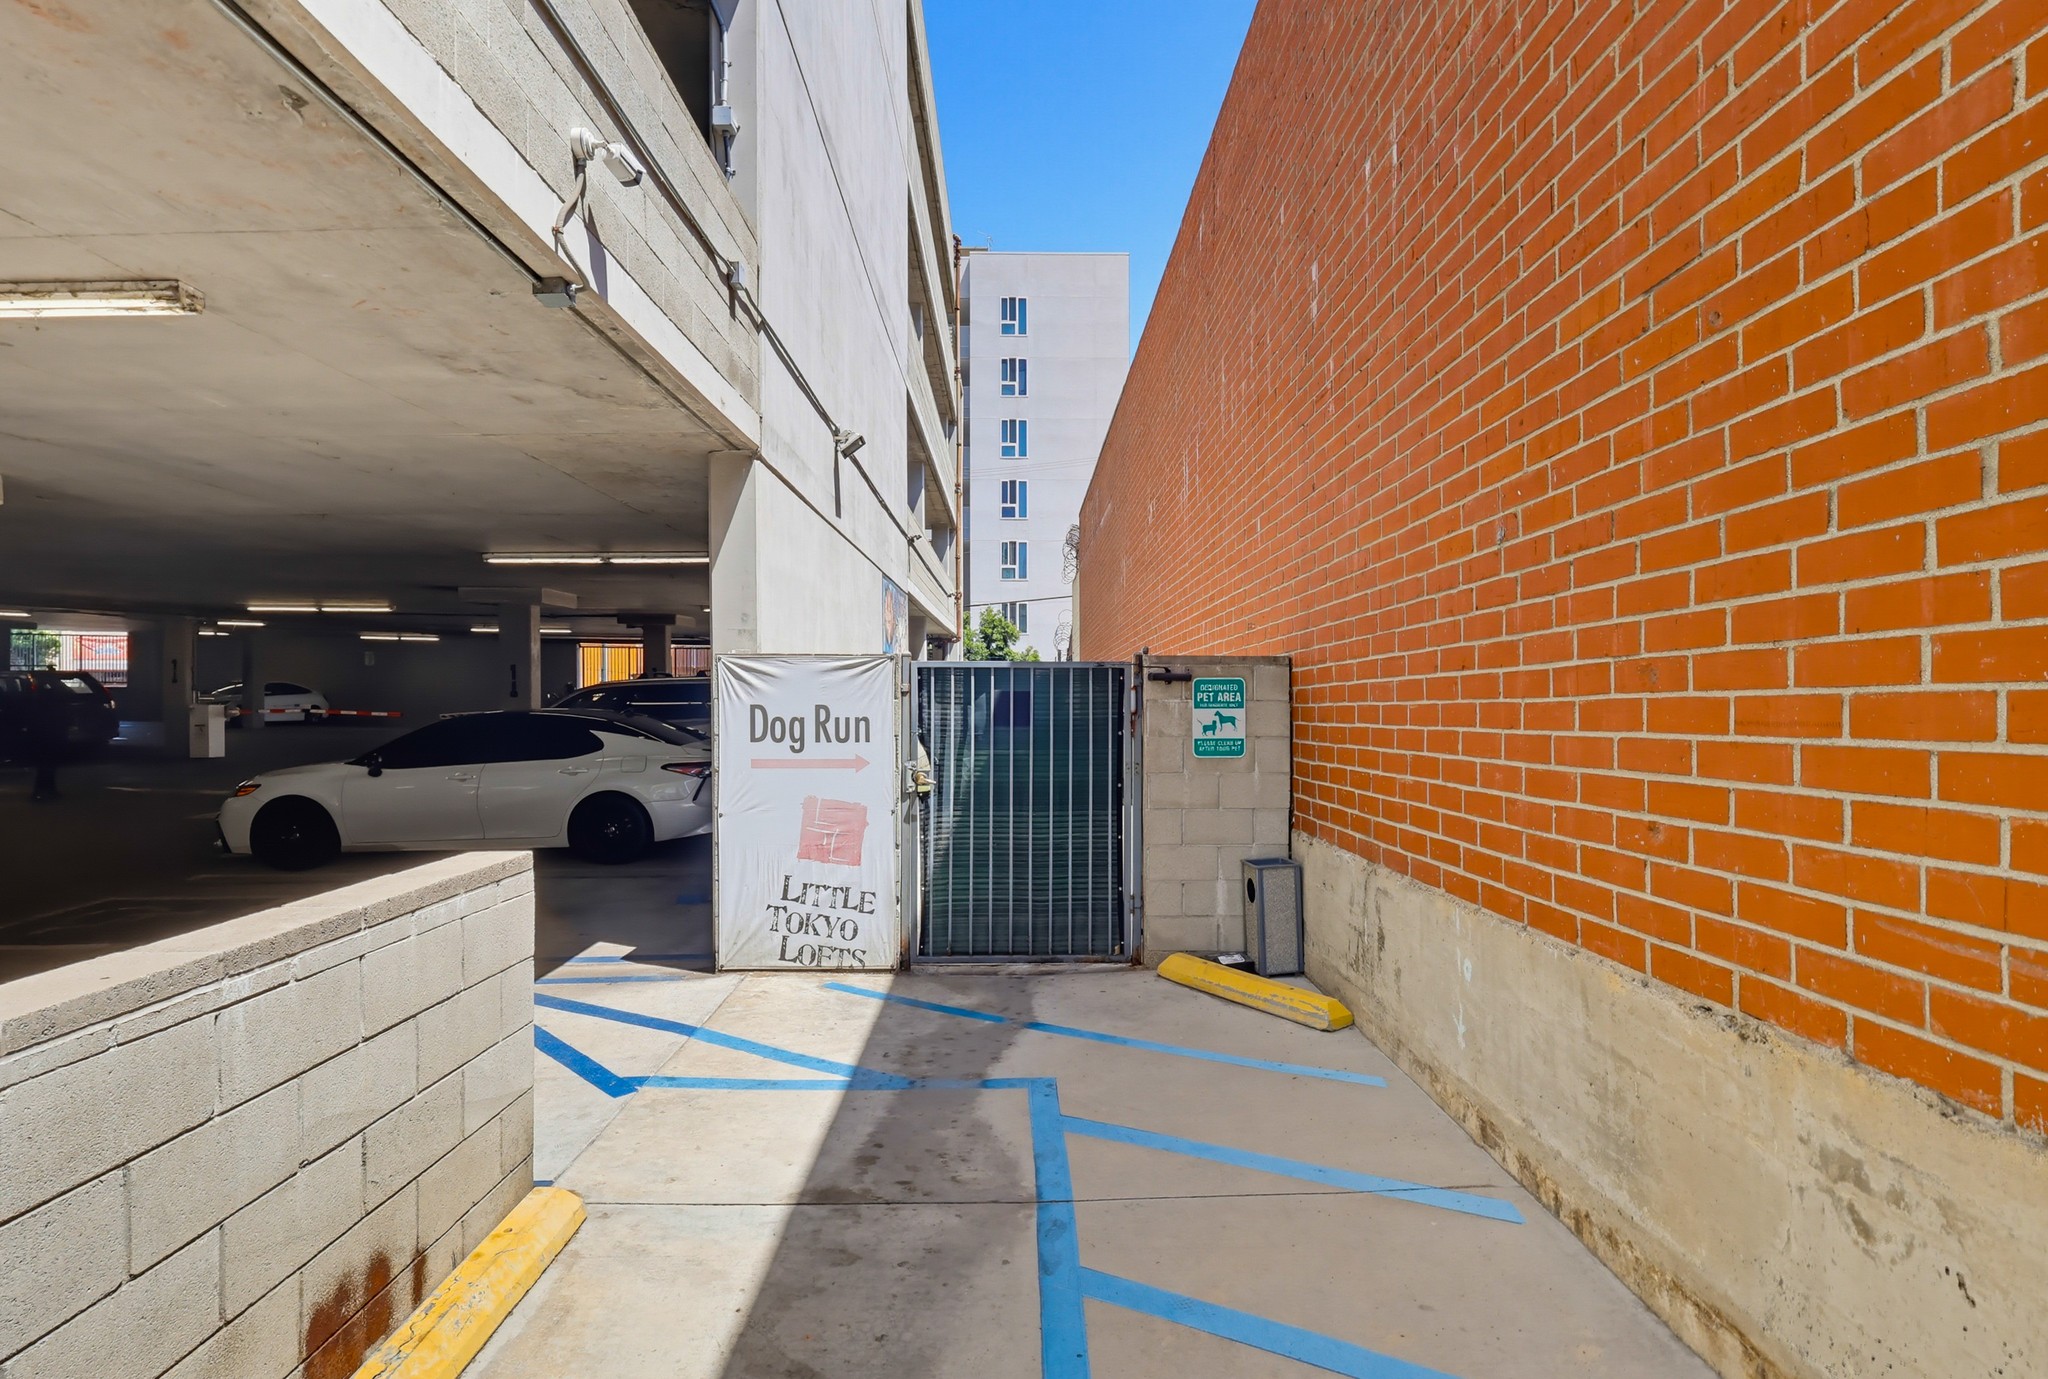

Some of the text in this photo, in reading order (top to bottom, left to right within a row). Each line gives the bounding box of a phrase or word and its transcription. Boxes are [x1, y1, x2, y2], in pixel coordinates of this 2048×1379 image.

[1197, 692, 1242, 702] PET AREA
[749, 704, 870, 754] Dog Run
[780, 874, 877, 915] LITTLE
[766, 904, 859, 942] TOKYO
[778, 935, 867, 969] LOFTS
